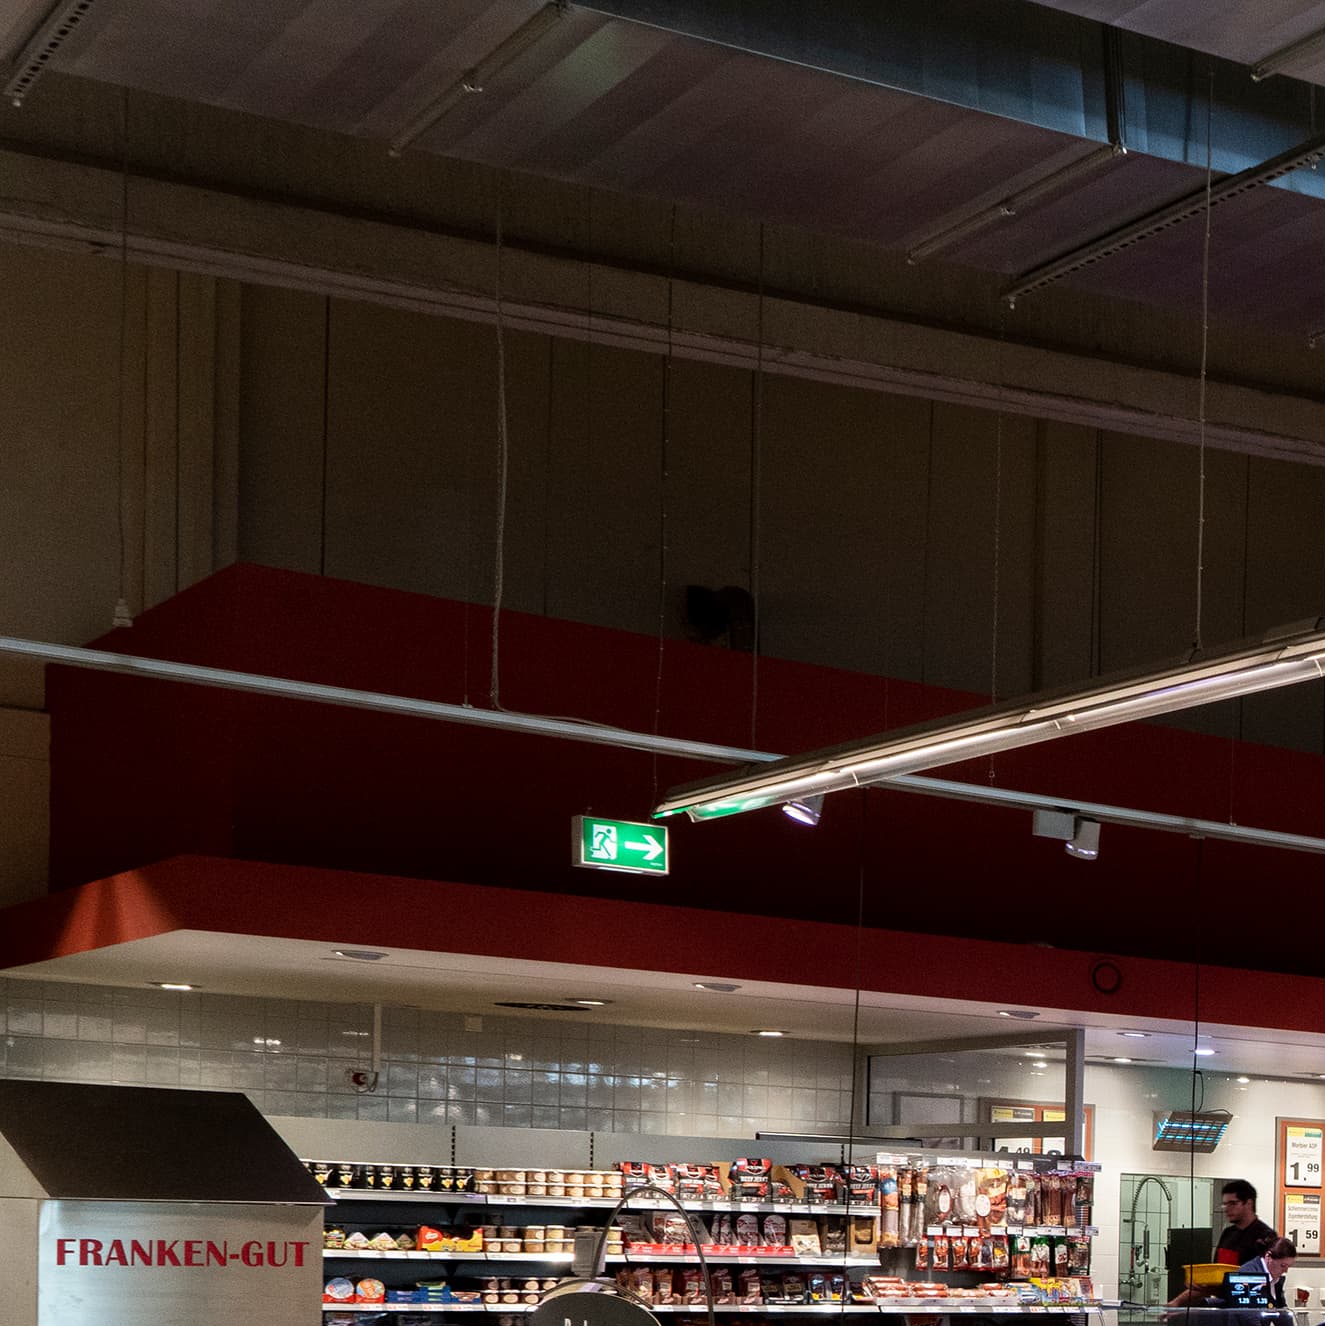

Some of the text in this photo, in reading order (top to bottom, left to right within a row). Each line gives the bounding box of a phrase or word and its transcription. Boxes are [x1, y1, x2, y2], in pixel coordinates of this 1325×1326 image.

[1290, 1162, 1320, 1181] 1.99
[1288, 1229, 1318, 1248] 1.59
[56, 1238, 310, 1267] FRANKEN-GUT
